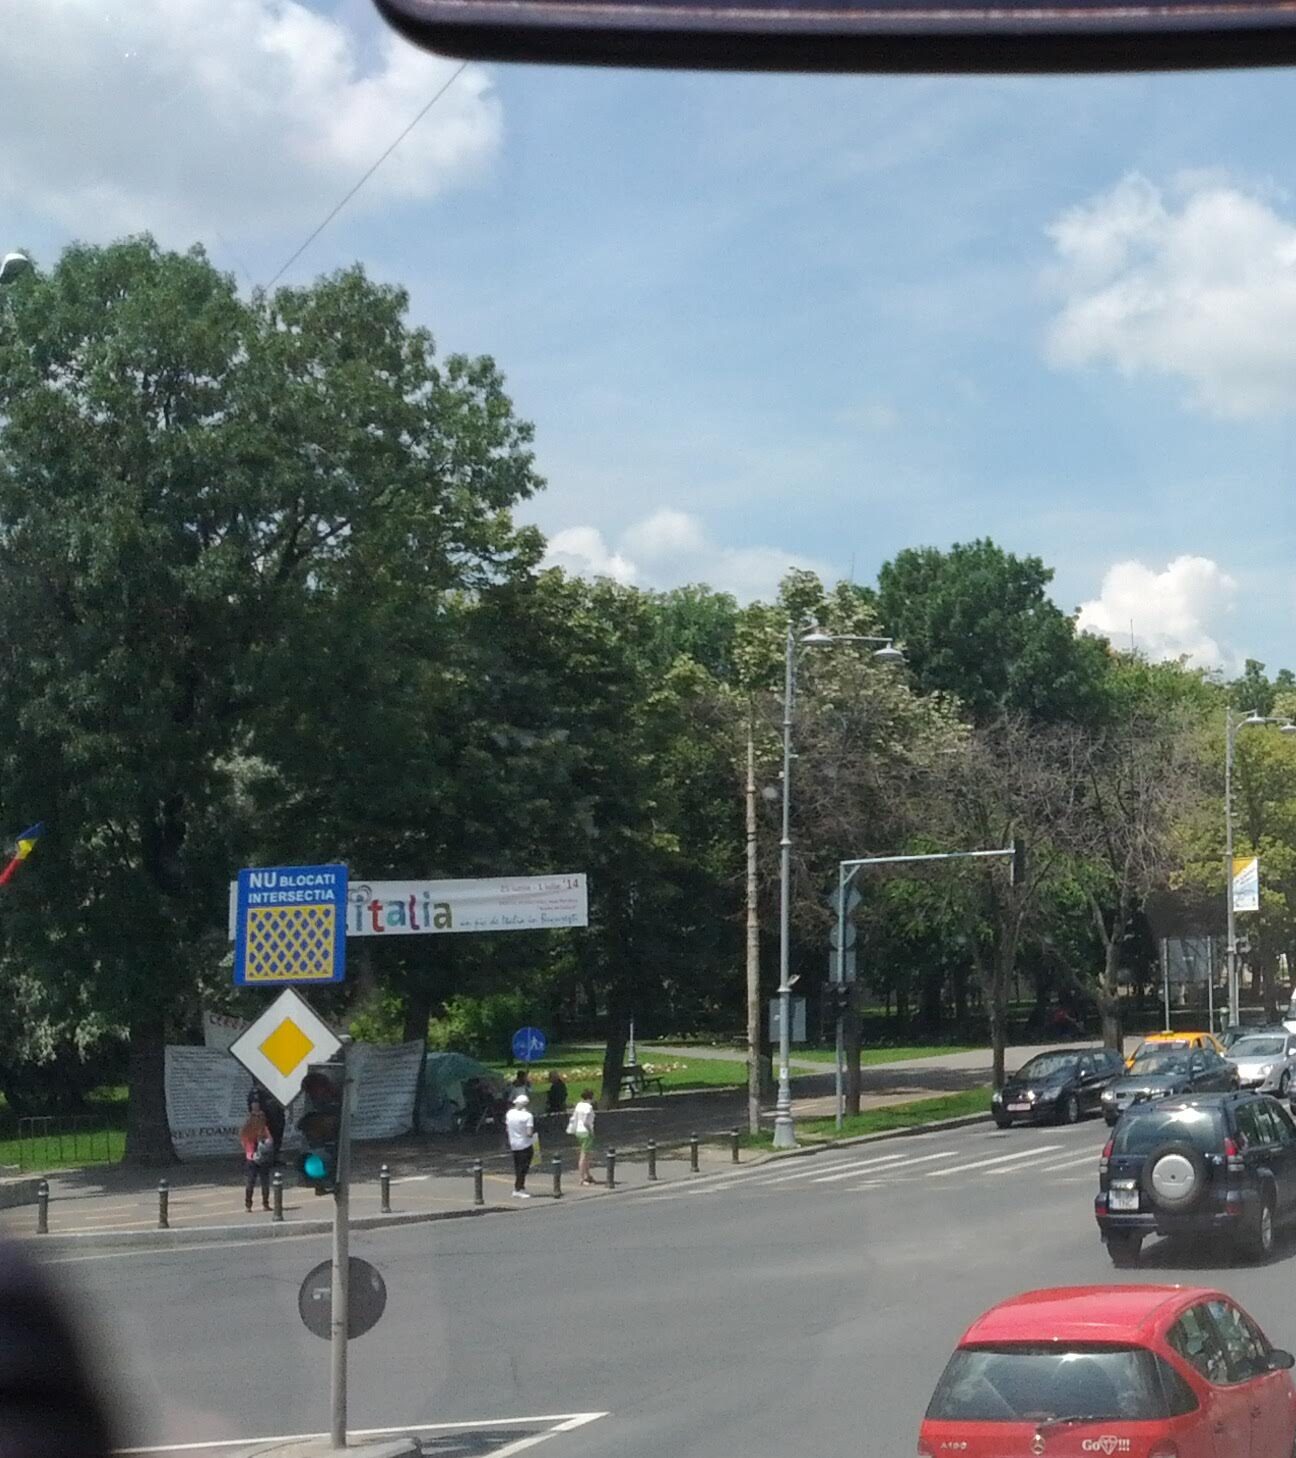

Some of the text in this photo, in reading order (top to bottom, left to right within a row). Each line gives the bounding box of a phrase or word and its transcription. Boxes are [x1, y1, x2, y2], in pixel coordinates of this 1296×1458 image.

[249, 872, 336, 888] NU BLOCATI
[248, 889, 336, 903] INTERSECTIA
[355, 890, 453, 932] italia
